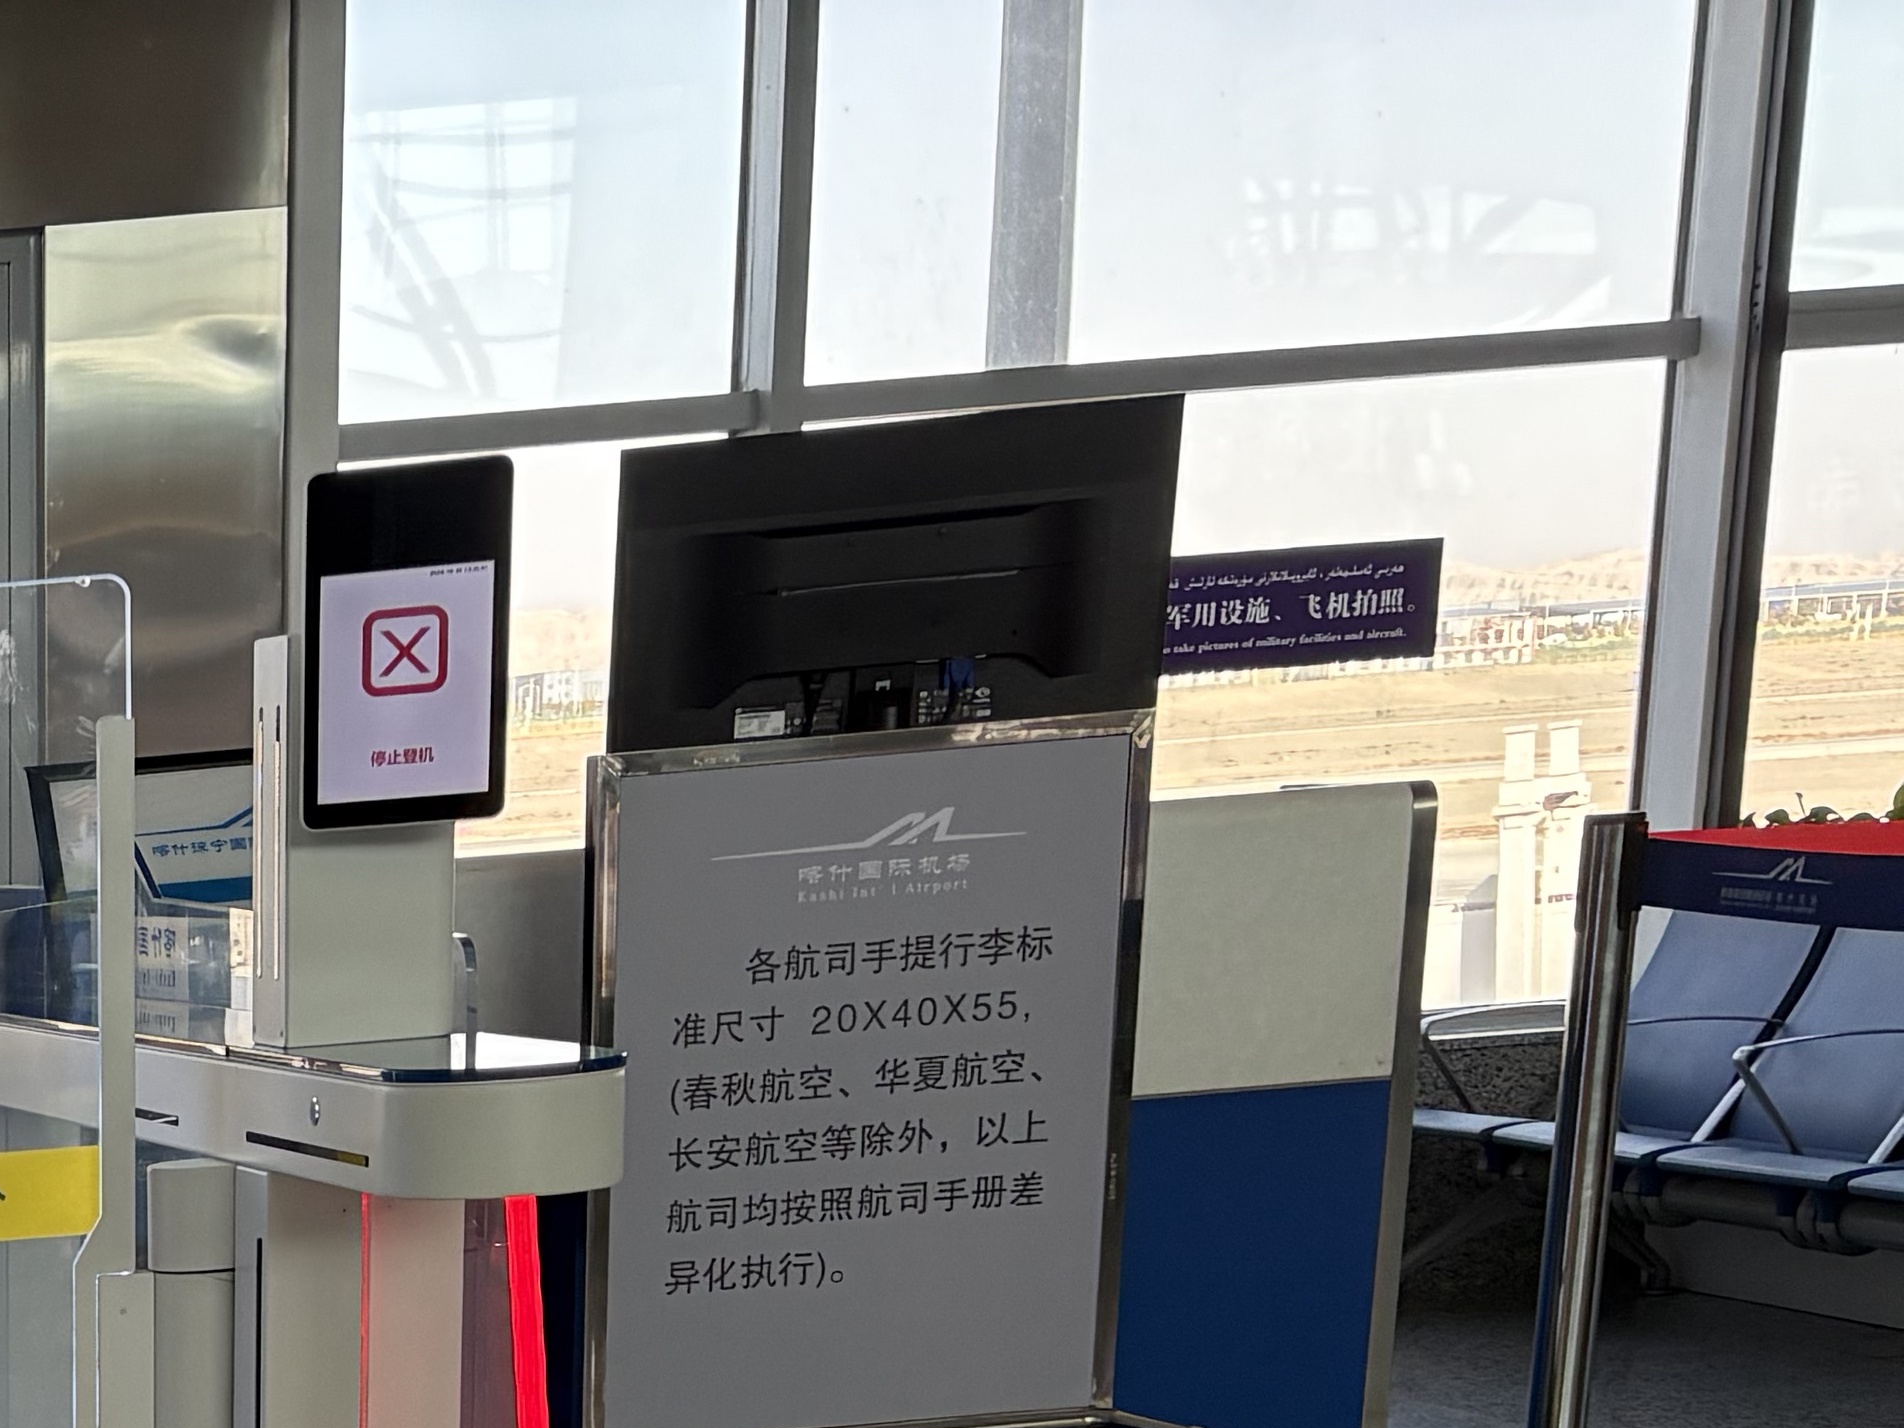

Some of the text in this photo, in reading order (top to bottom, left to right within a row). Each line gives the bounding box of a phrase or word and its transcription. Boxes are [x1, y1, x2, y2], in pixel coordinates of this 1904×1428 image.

[1198, 640, 1240, 654] pictures
[1242, 637, 1254, 648] of
[1256, 634, 1296, 648] military
[1344, 630, 1364, 641] and
[370, 746, 435, 767] 停止登机
[798, 853, 971, 884] 喀什国际机场
[797, 887, 844, 903] Kashi
[905, 879, 968, 896] Airport
[745, 925, 1053, 985] 各航司手提行李标
[671, 1005, 786, 1049] 准尺寸
[665, 1171, 1045, 1234] 航司均按照航司手册差
[664, 1250, 845, 1296] 异化执行)。
